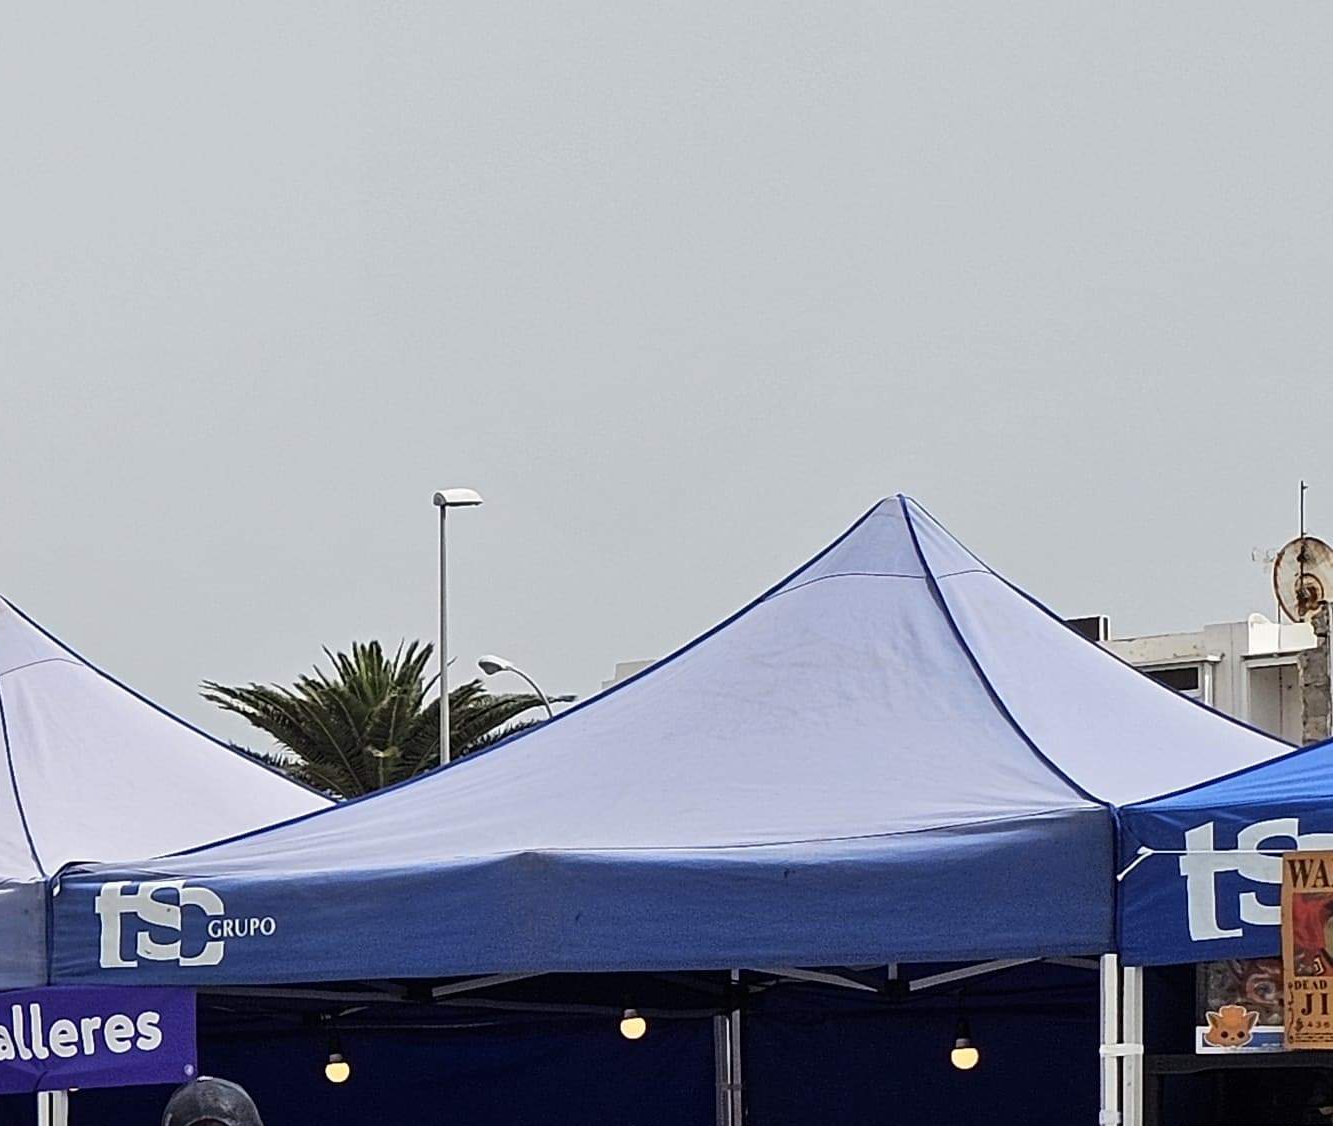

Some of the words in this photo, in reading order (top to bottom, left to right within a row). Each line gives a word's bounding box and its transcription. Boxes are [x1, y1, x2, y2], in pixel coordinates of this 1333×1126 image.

[1179, 818, 1333, 941] ts
[1287, 858, 1333, 889] WA
[208, 917, 276, 938] GRUPO
